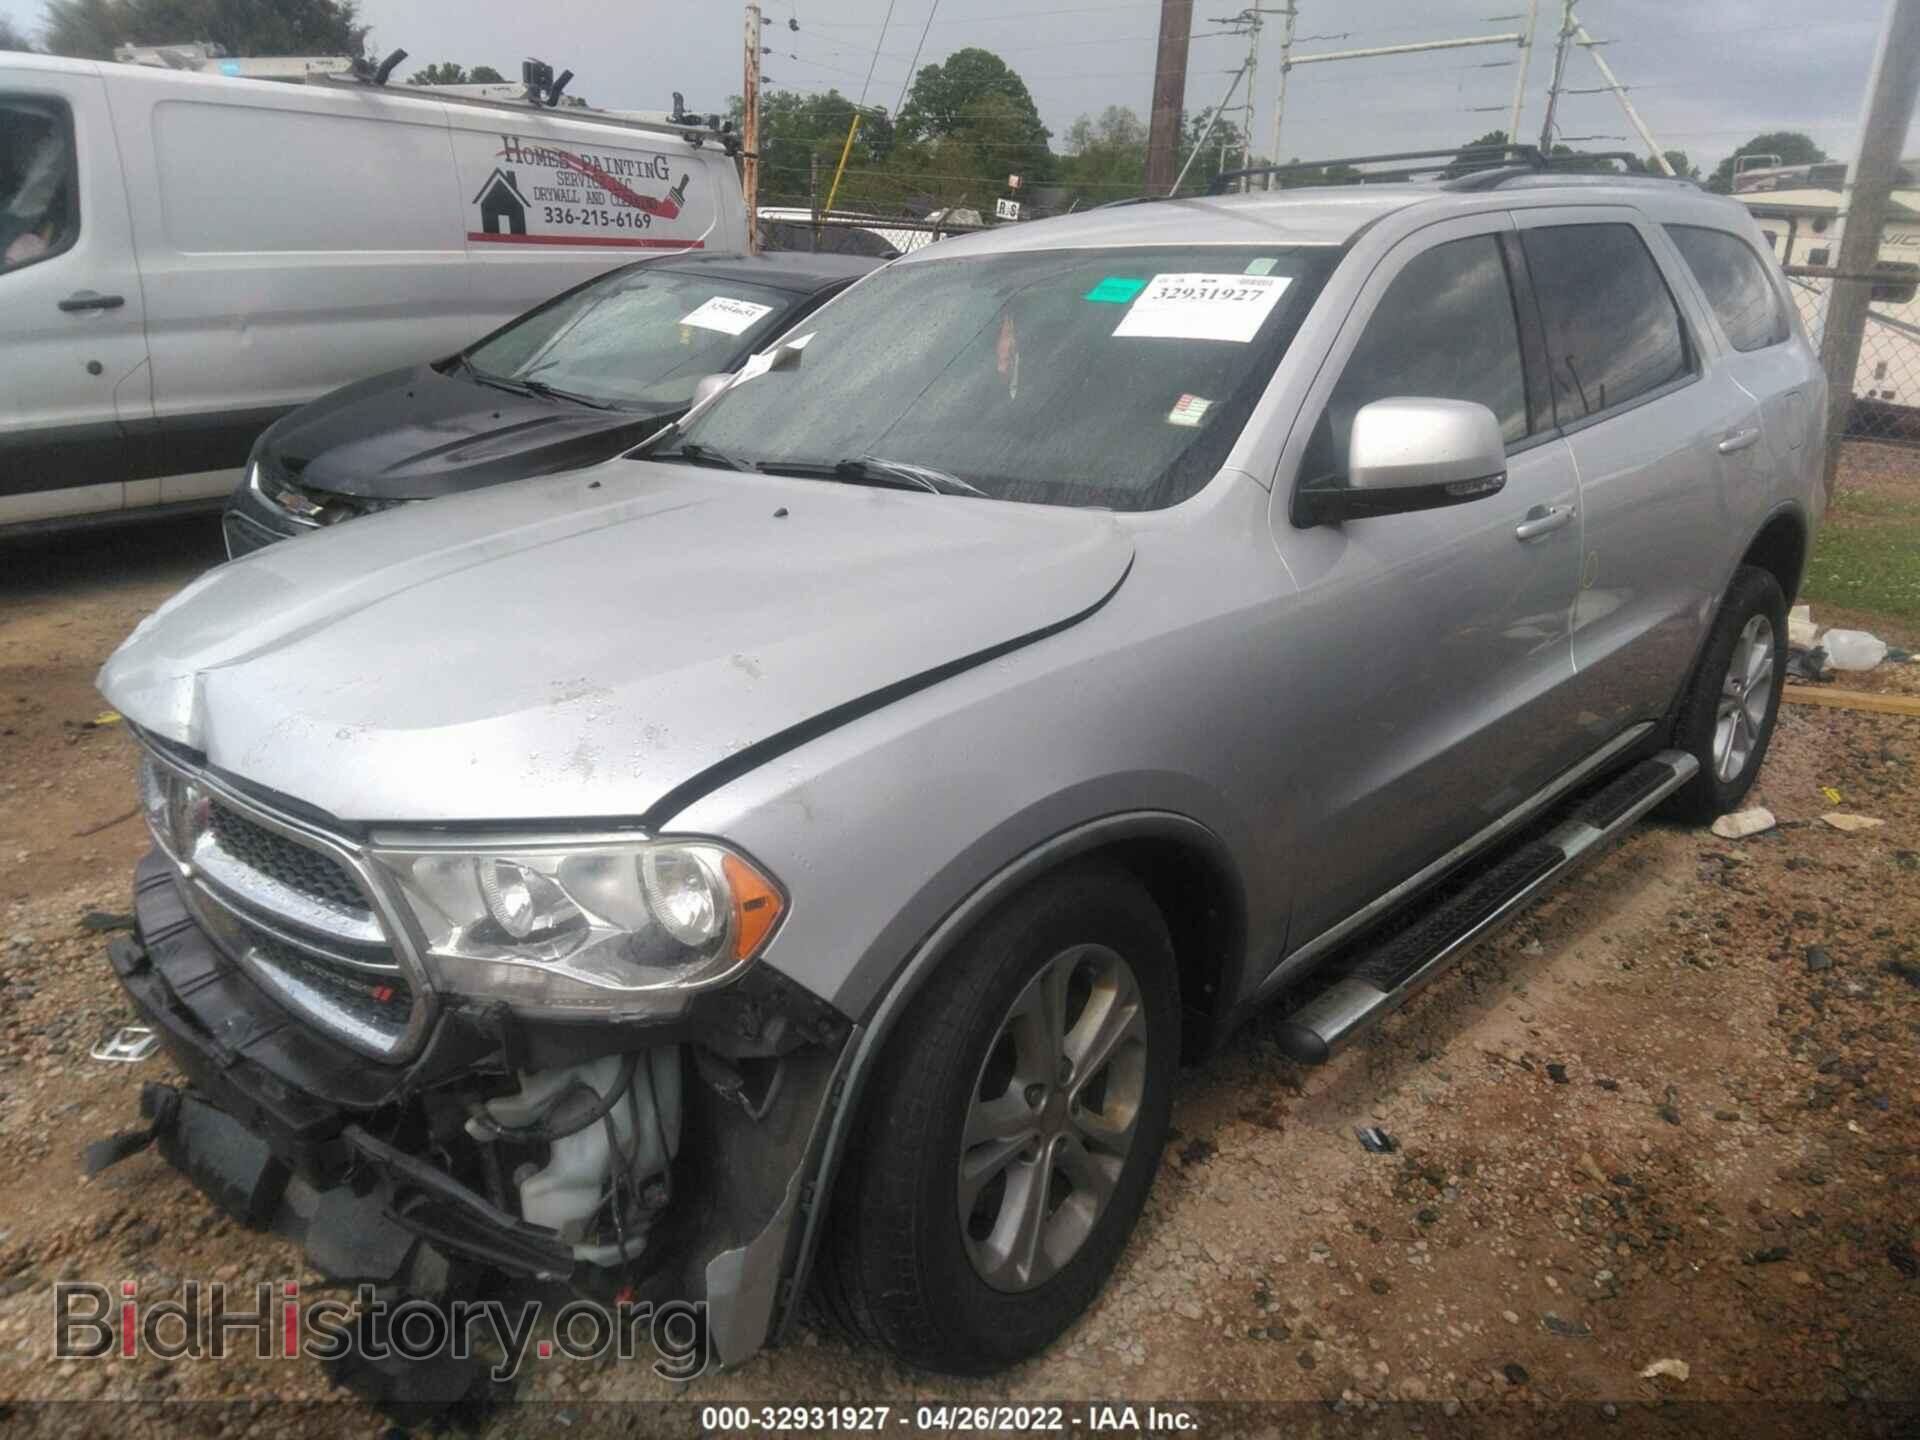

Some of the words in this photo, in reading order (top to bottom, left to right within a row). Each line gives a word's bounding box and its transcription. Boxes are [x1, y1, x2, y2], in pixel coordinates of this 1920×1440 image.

[502, 136, 570, 169] HOMES
[581, 154, 669, 181] PAINTING
[556, 171, 608, 190] SERVIC
[533, 187, 580, 203] DRYWALL
[586, 190, 606, 206] AND
[544, 206, 652, 229] 336-215-6169
[1152, 286, 1265, 302] 32931927
